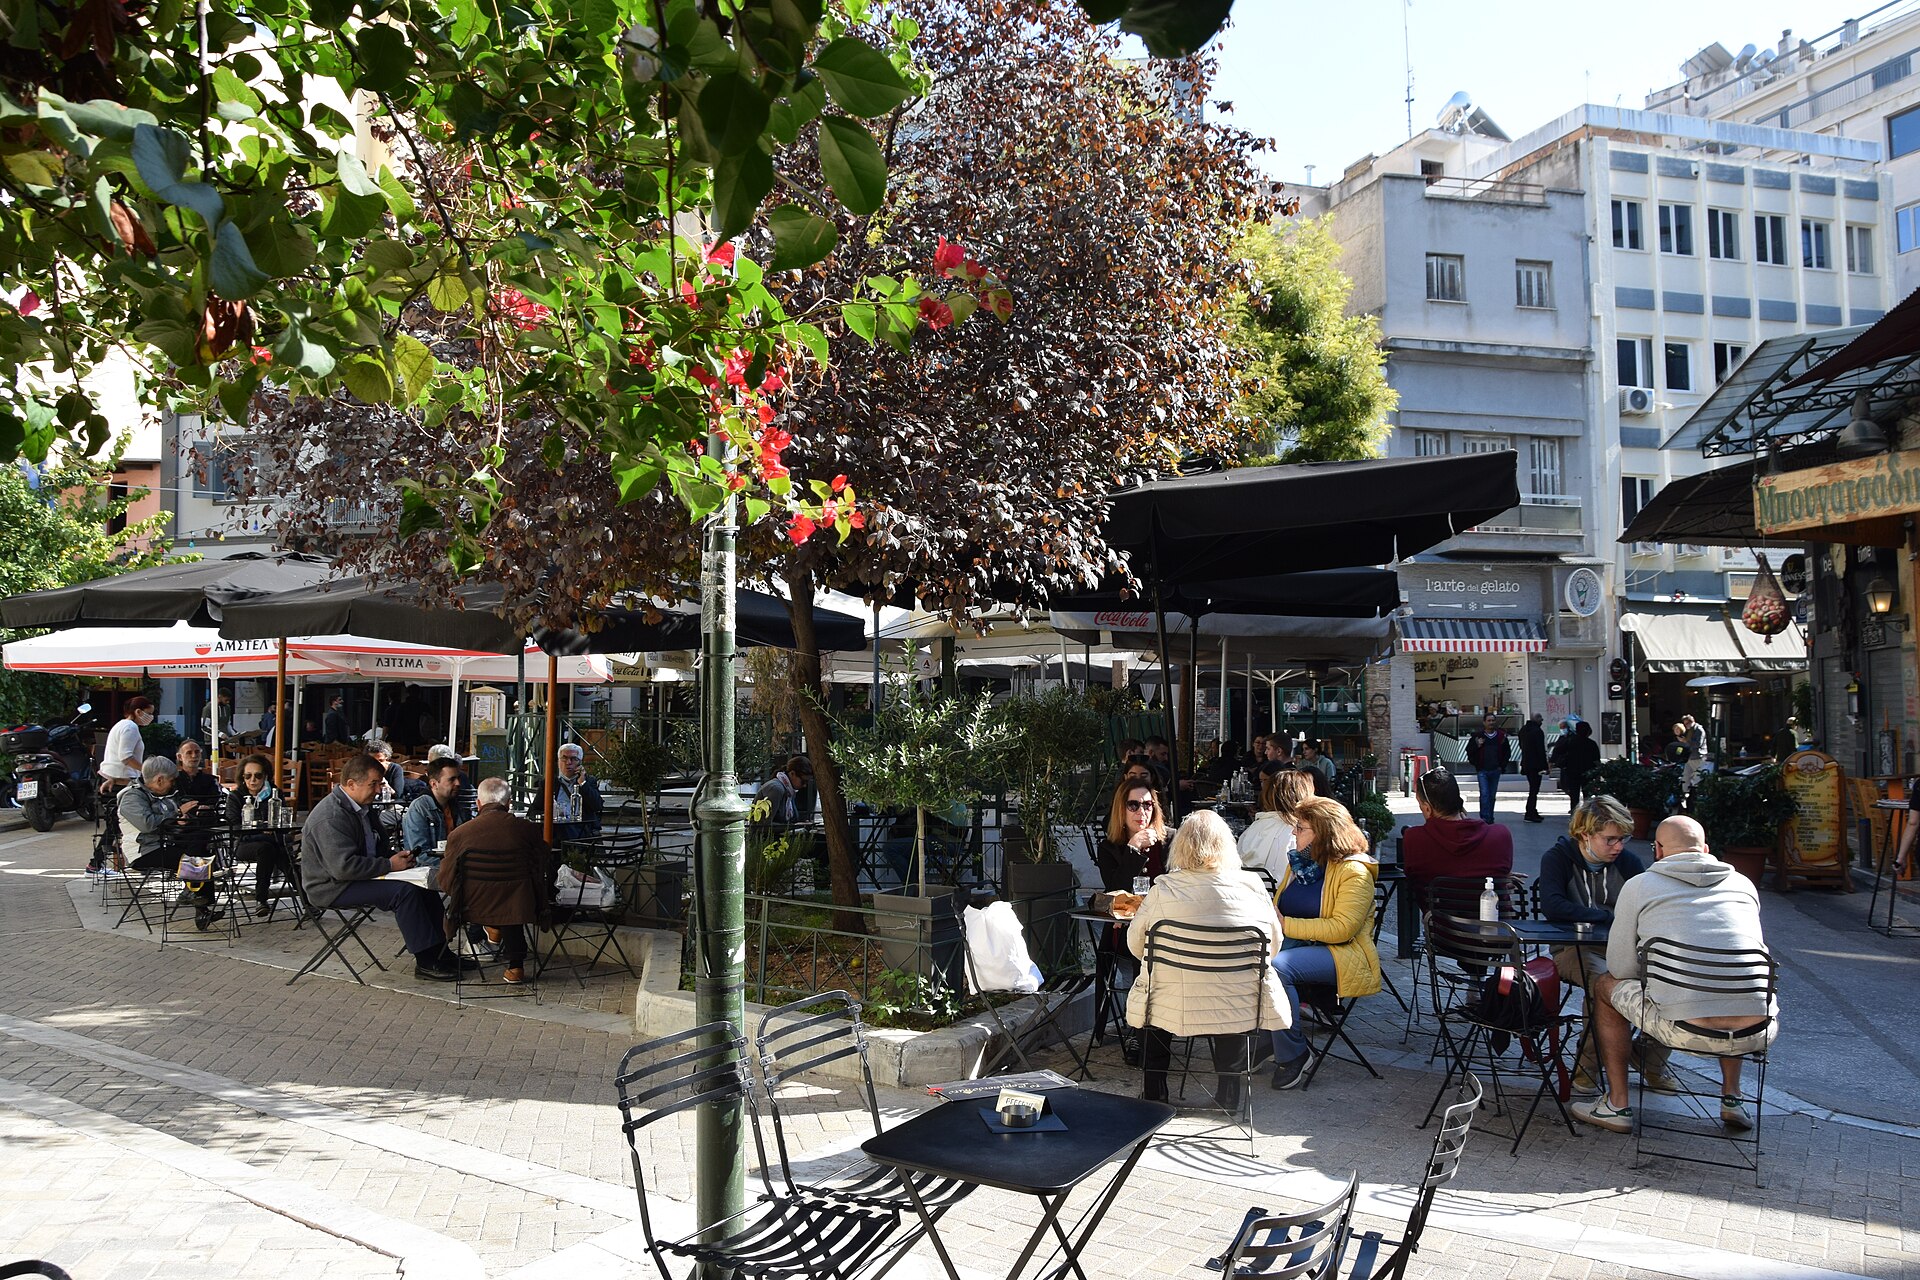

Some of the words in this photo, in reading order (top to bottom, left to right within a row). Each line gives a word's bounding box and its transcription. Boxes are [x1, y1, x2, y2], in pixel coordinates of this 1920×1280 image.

[1425, 579, 1465, 592] l'arte
[1467, 584, 1479, 592] del
[1480, 580, 1520, 595] gelato
[214, 639, 268, 652] ΑΜΣΤΕΛ
